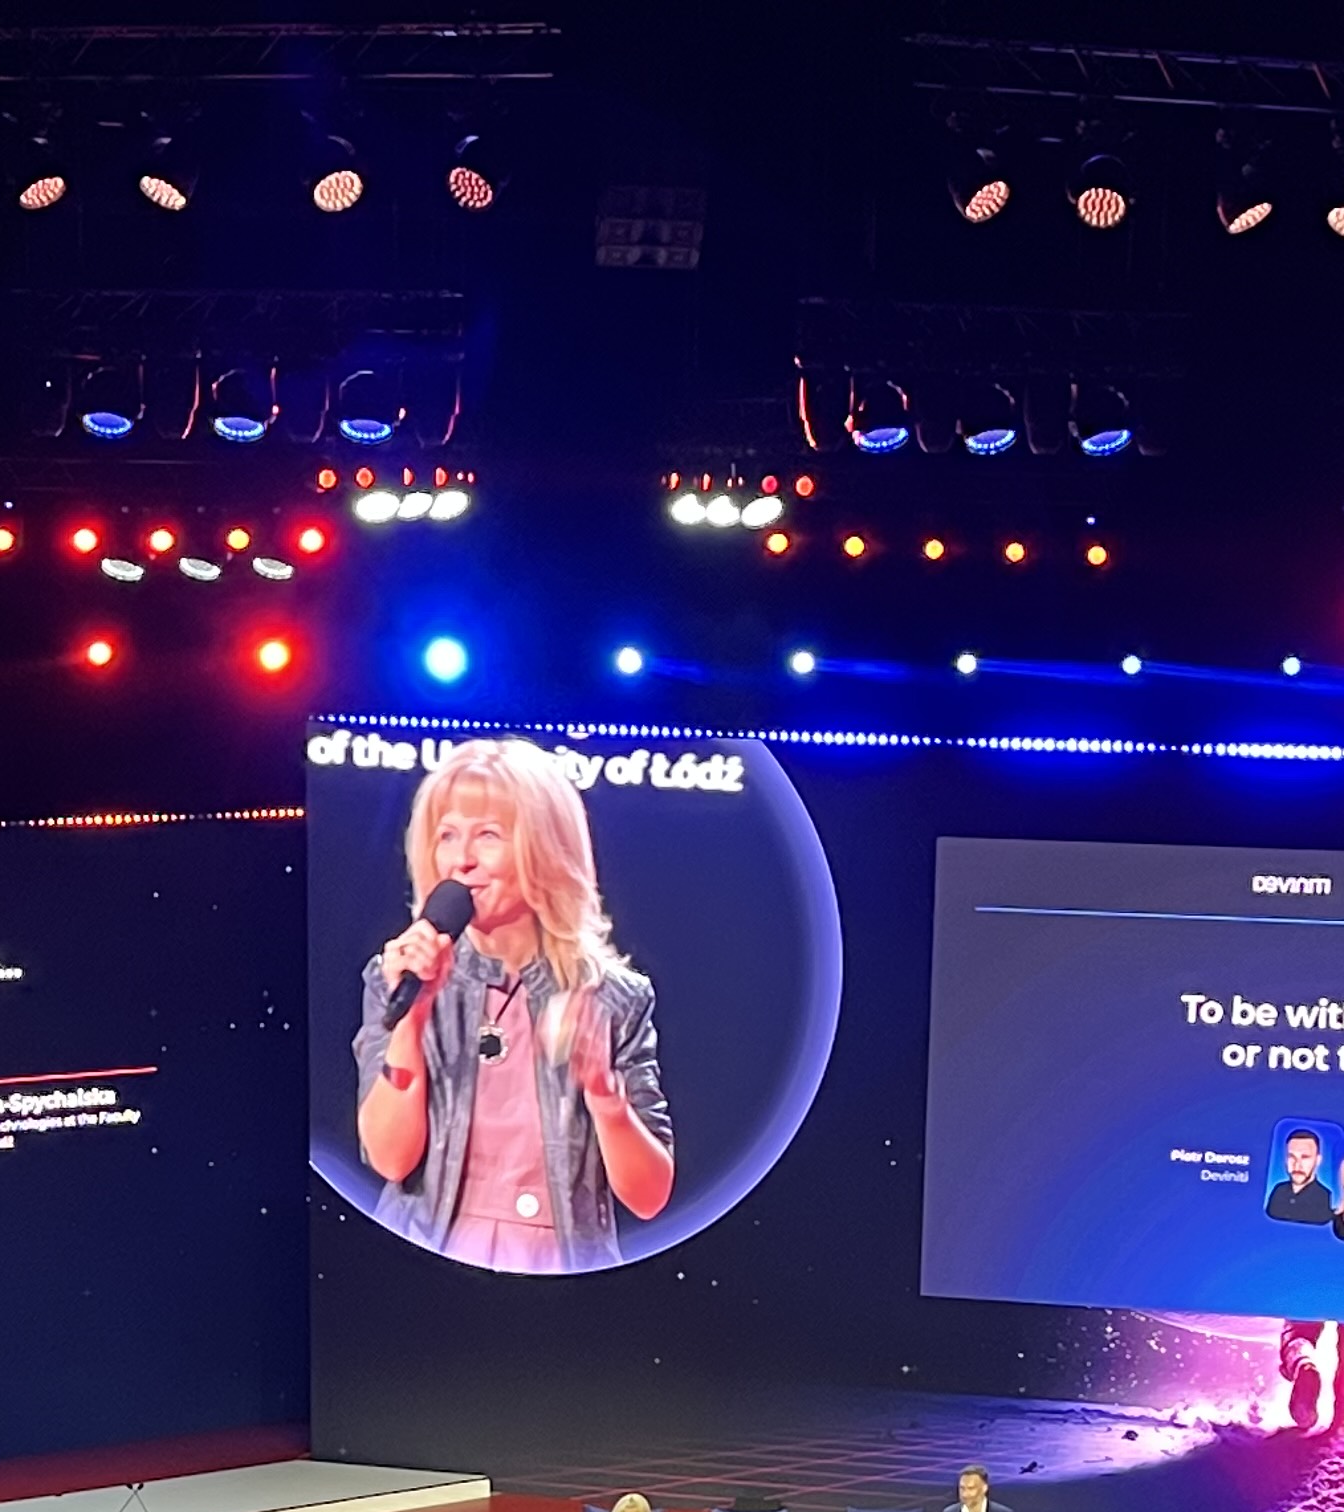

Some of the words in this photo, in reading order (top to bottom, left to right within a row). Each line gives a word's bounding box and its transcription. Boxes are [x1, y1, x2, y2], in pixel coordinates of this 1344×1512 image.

[308, 730, 350, 764] of
[353, 735, 416, 770] the
[605, 750, 649, 784] of
[651, 752, 743, 792] Łódź
[1181, 995, 1224, 1024] To
[1231, 995, 1278, 1026] be
[1222, 1043, 1262, 1068] or
[1269, 1044, 1329, 1071] not
